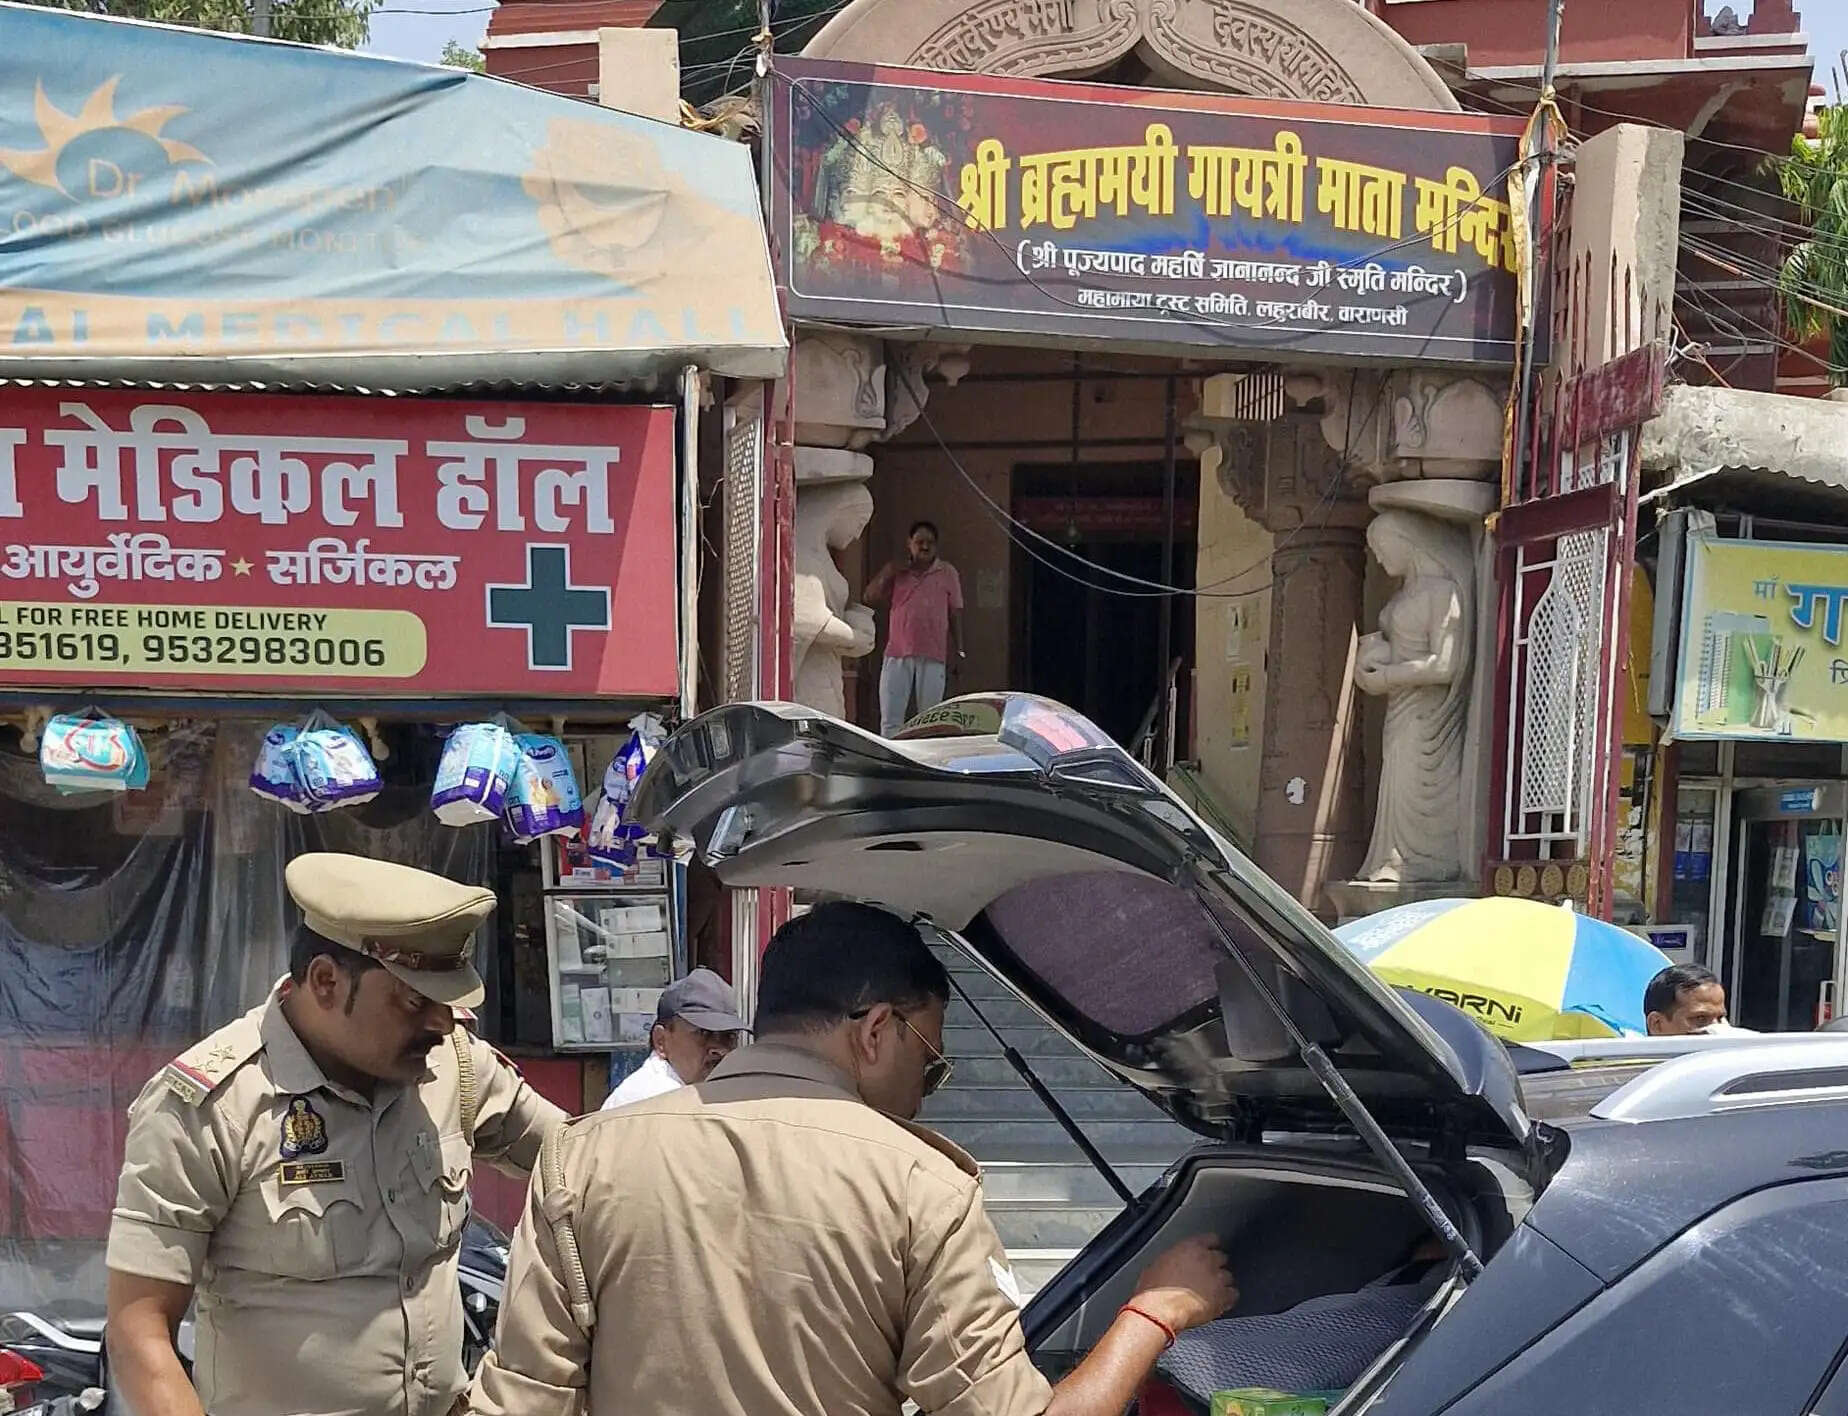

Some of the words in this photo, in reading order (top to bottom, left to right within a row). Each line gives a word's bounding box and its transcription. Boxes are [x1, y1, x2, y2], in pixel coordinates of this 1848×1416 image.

[957, 138, 1011, 231] श्री
[1187, 130, 1308, 223] गायत्री
[1316, 156, 1406, 240] माता
[1305, 260, 1331, 288] जी
[1077, 288, 1152, 310] महामाया
[1338, 303, 1408, 326] वाराणसी
[44, 402, 408, 529] मेडिकल
[427, 414, 620, 534] हॉल
[1, 532, 226, 599] आयुर्वेदिक
[265, 537, 462, 592] सर्जिकल
[16, 607, 63, 627] FOR
[71, 608, 129, 628] FREE
[137, 610, 206, 630] HOME
[215, 611, 328, 632] DELIVERY
[143, 634, 386, 668] 9532983006
[1406, 986, 1522, 1025] ARNi
